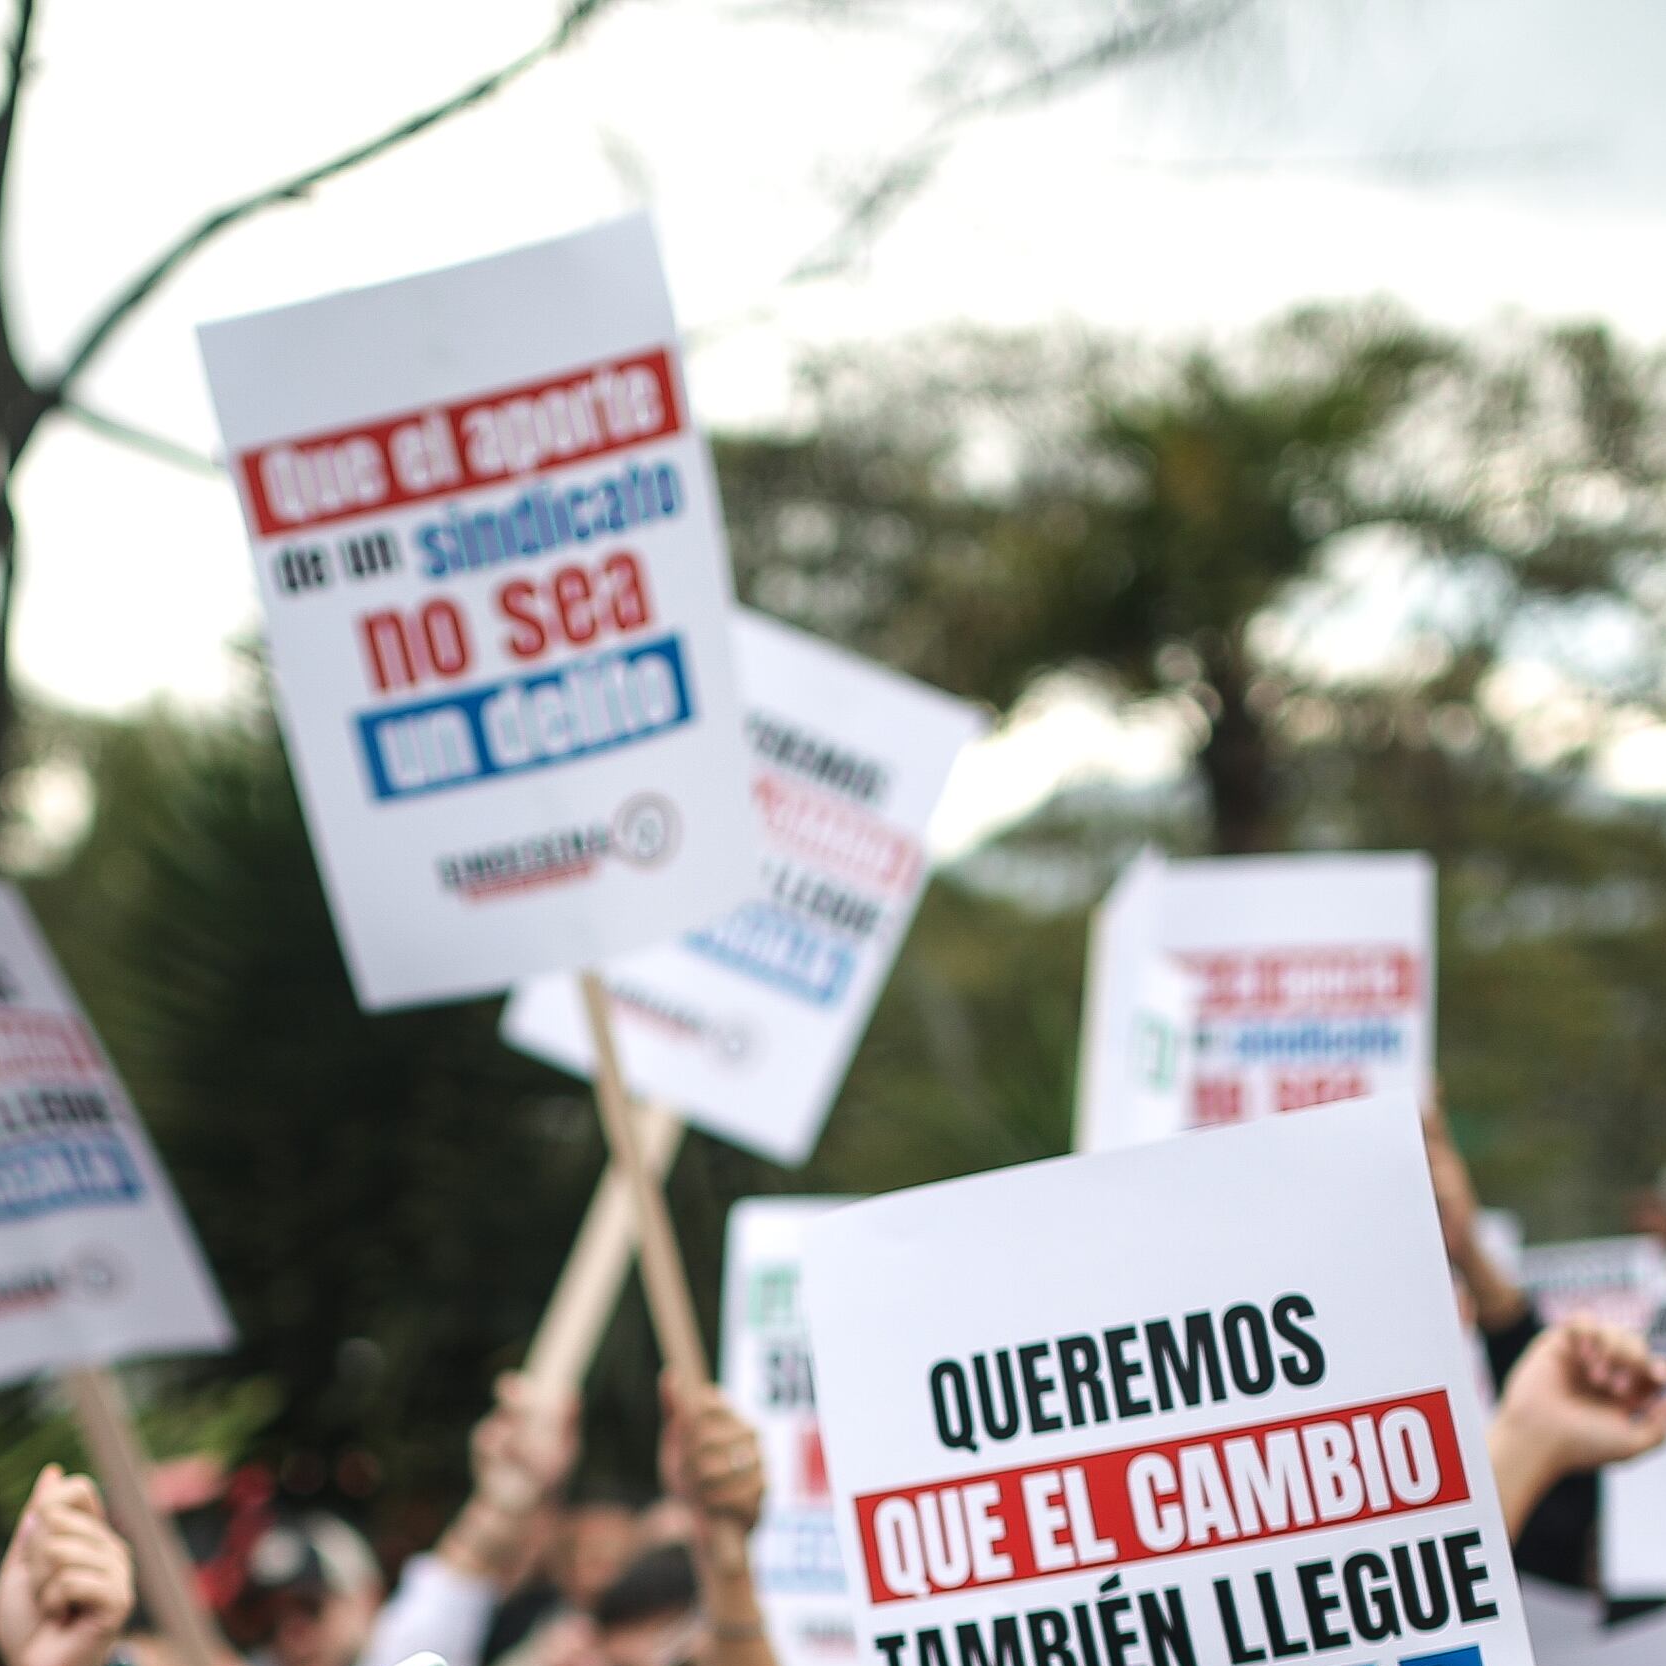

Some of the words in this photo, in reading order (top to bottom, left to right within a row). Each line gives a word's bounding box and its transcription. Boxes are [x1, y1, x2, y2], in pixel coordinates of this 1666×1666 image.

[261, 442, 381, 520] Que
[397, 418, 455, 488] el
[467, 364, 661, 478] aporte
[415, 460, 683, 577] sindicato
[360, 597, 470, 694] no
[496, 550, 653, 662] sea
[380, 704, 473, 786] un
[489, 646, 681, 762] delito
[929, 1293, 1325, 1452] QUEREMOS
[874, 1482, 1011, 1596] QUE
[1023, 1465, 1115, 1570] EL
[1126, 1406, 1440, 1550] CAMBIO
[1214, 1532, 1498, 1666] LLEGUE
